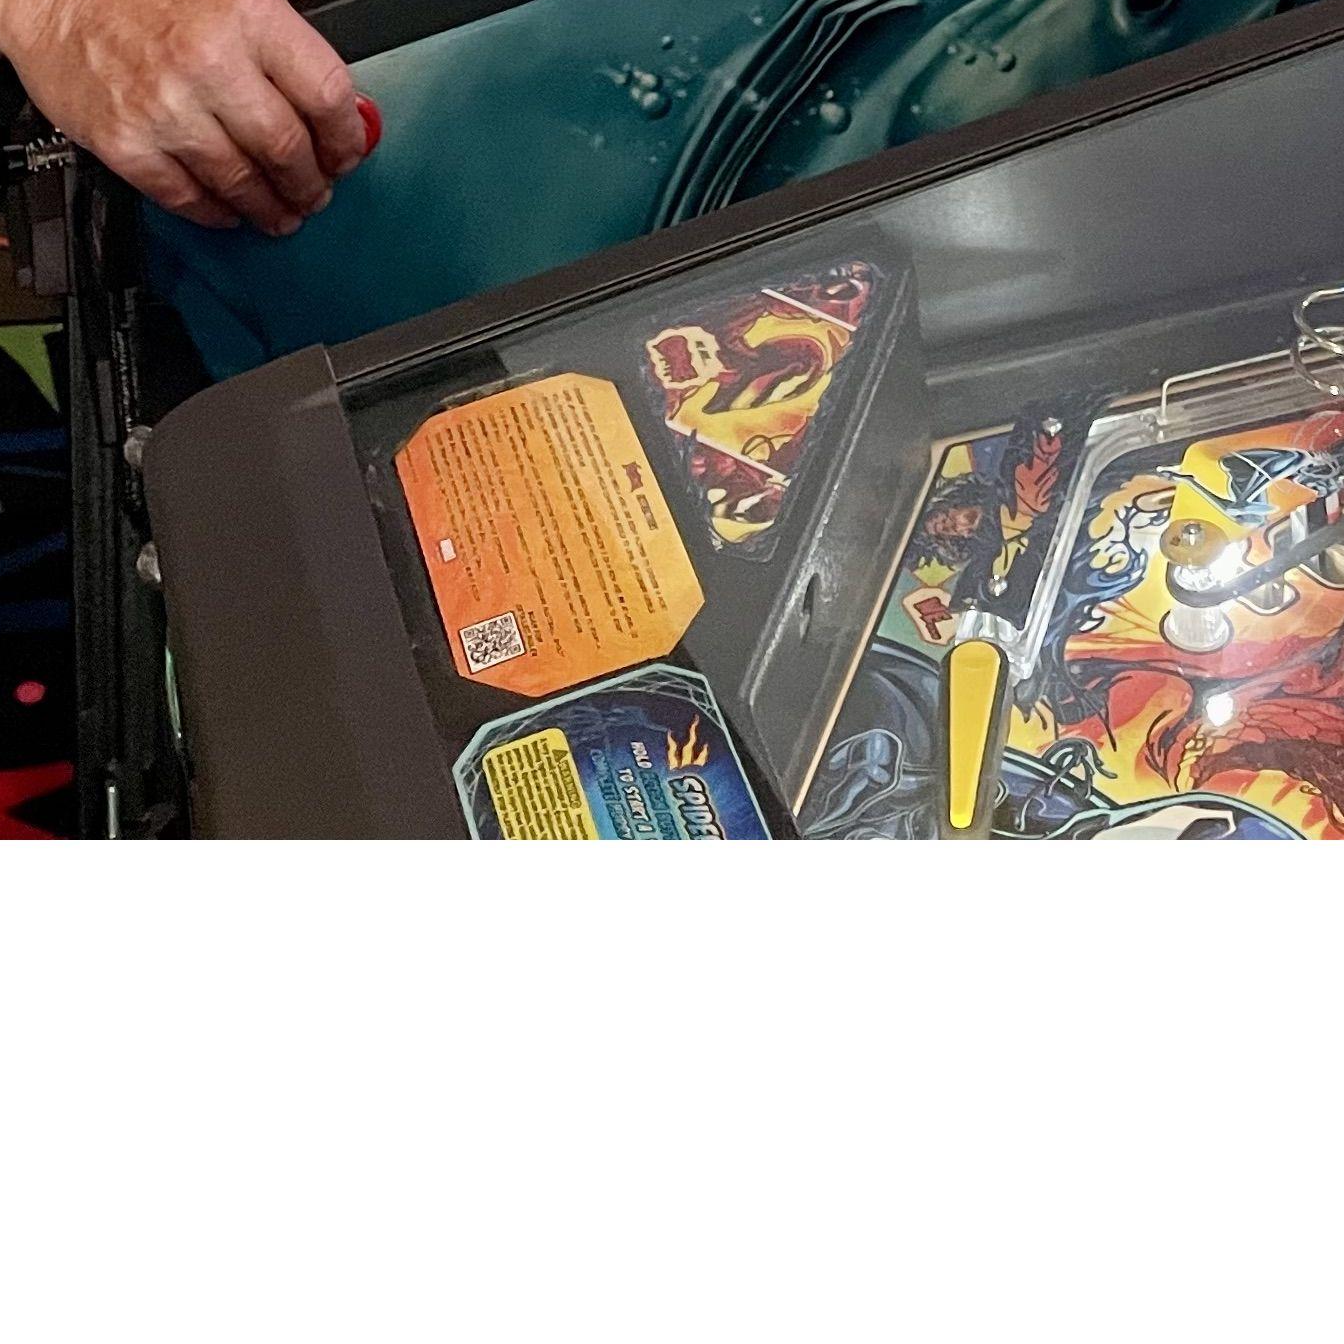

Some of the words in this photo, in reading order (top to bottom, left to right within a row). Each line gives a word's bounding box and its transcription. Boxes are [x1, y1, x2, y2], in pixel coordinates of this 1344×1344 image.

[630, 741, 653, 769] HOLD
[557, 759, 582, 810] WARNING
[618, 768, 635, 783] TO
[624, 785, 651, 822] START
